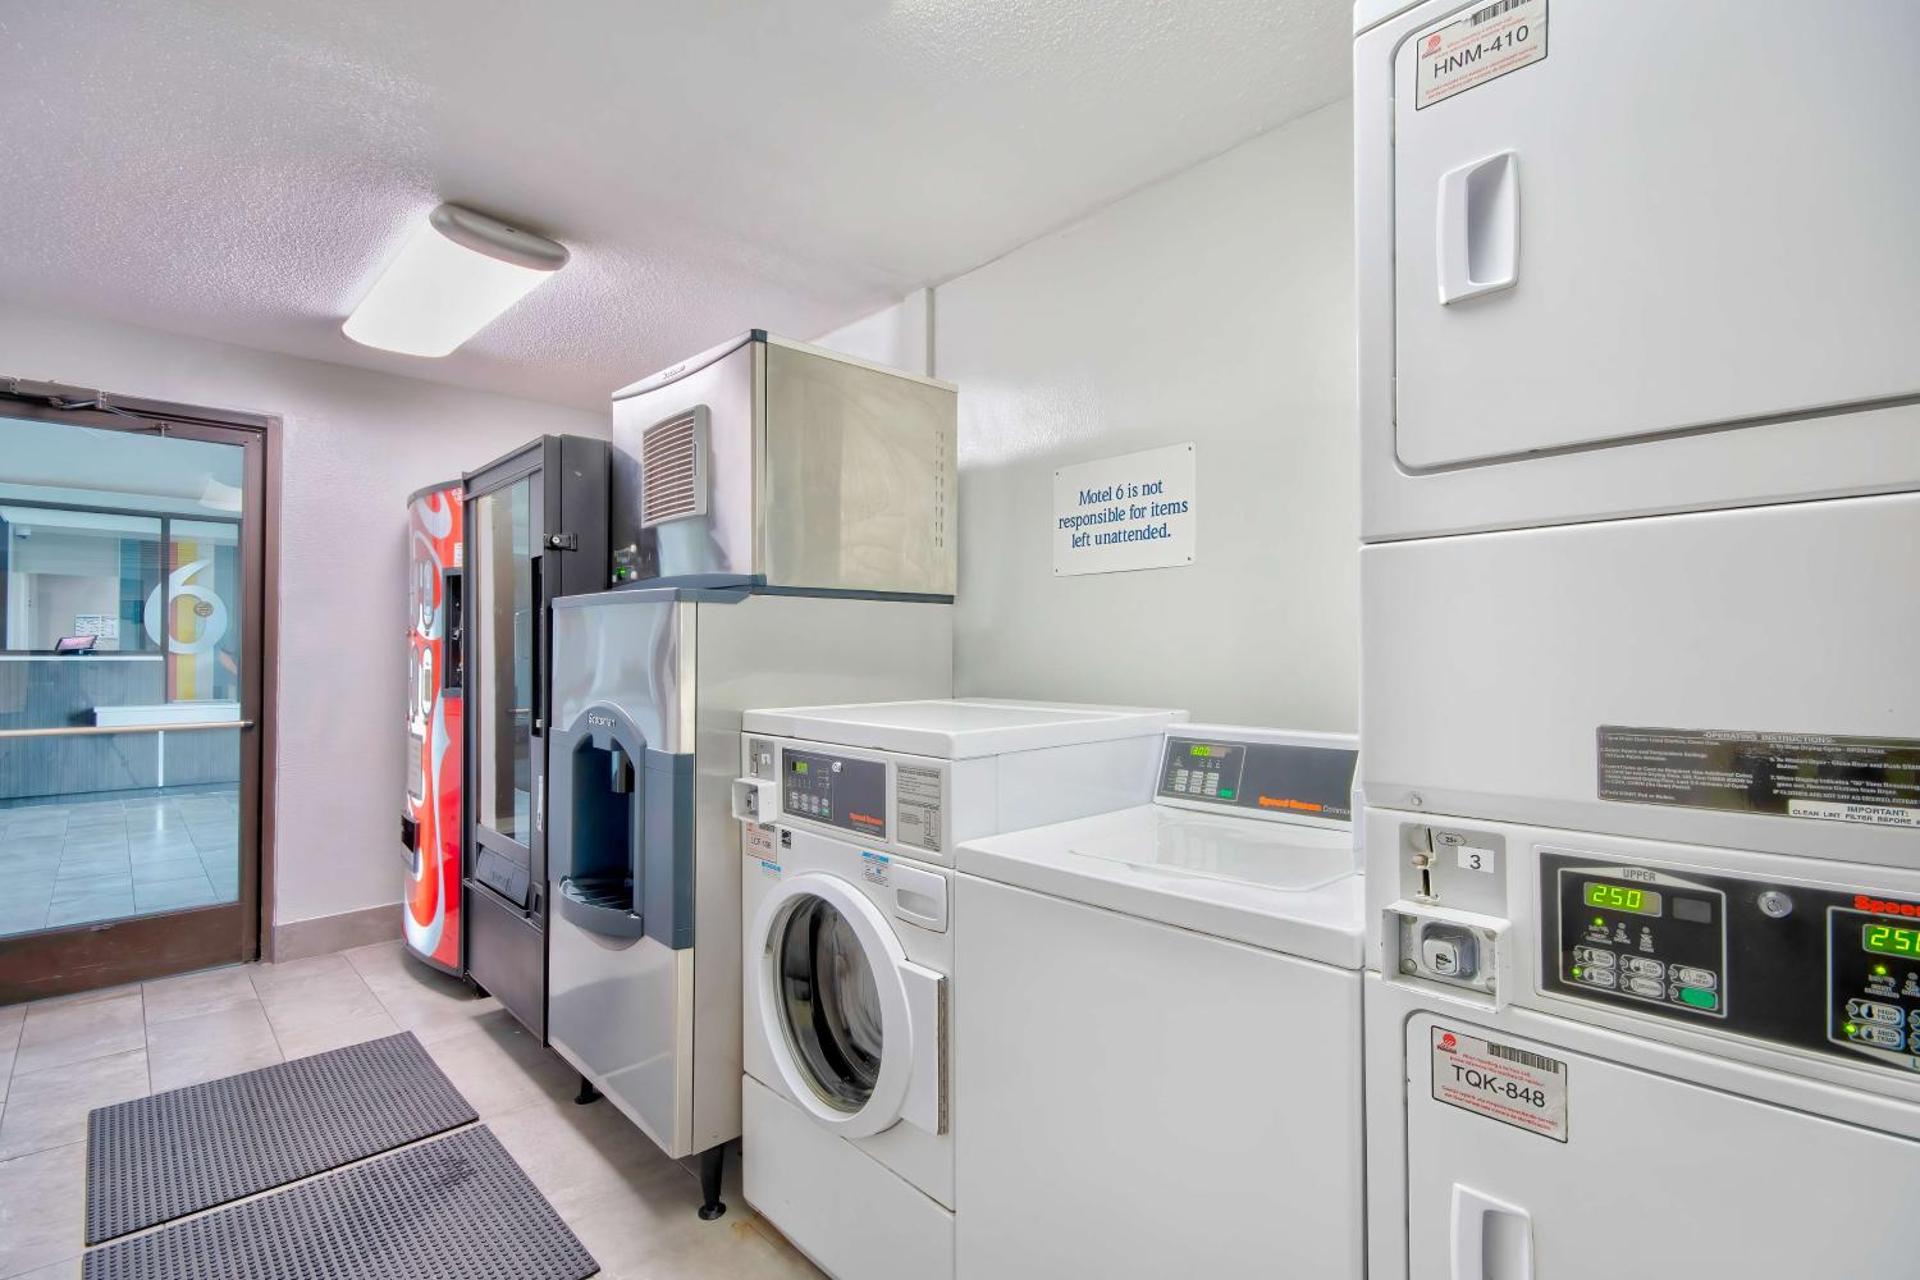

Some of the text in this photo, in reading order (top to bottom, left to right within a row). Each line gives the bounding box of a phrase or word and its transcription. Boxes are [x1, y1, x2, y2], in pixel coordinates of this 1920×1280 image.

[1433, 25, 1529, 79] HNM-410
[1078, 479, 1163, 506] Motel 6 is not
[1058, 500, 1189, 530] responsible for items
[1071, 522, 1172, 549] left unattended.
[144, 558, 228, 655] 6
[1792, 809, 1820, 818] CLEAN
[1823, 811, 1841, 819] LINT
[1845, 813, 1873, 822] FILTER
[1877, 816, 1912, 825] BEFORE
[1846, 805, 1909, 818] IMPORTANT:
[1470, 854, 1481, 870] 3
[1622, 868, 1656, 882] UPPER
[1592, 884, 1641, 909] 250
[1451, 1064, 1546, 1108] TQK-848
